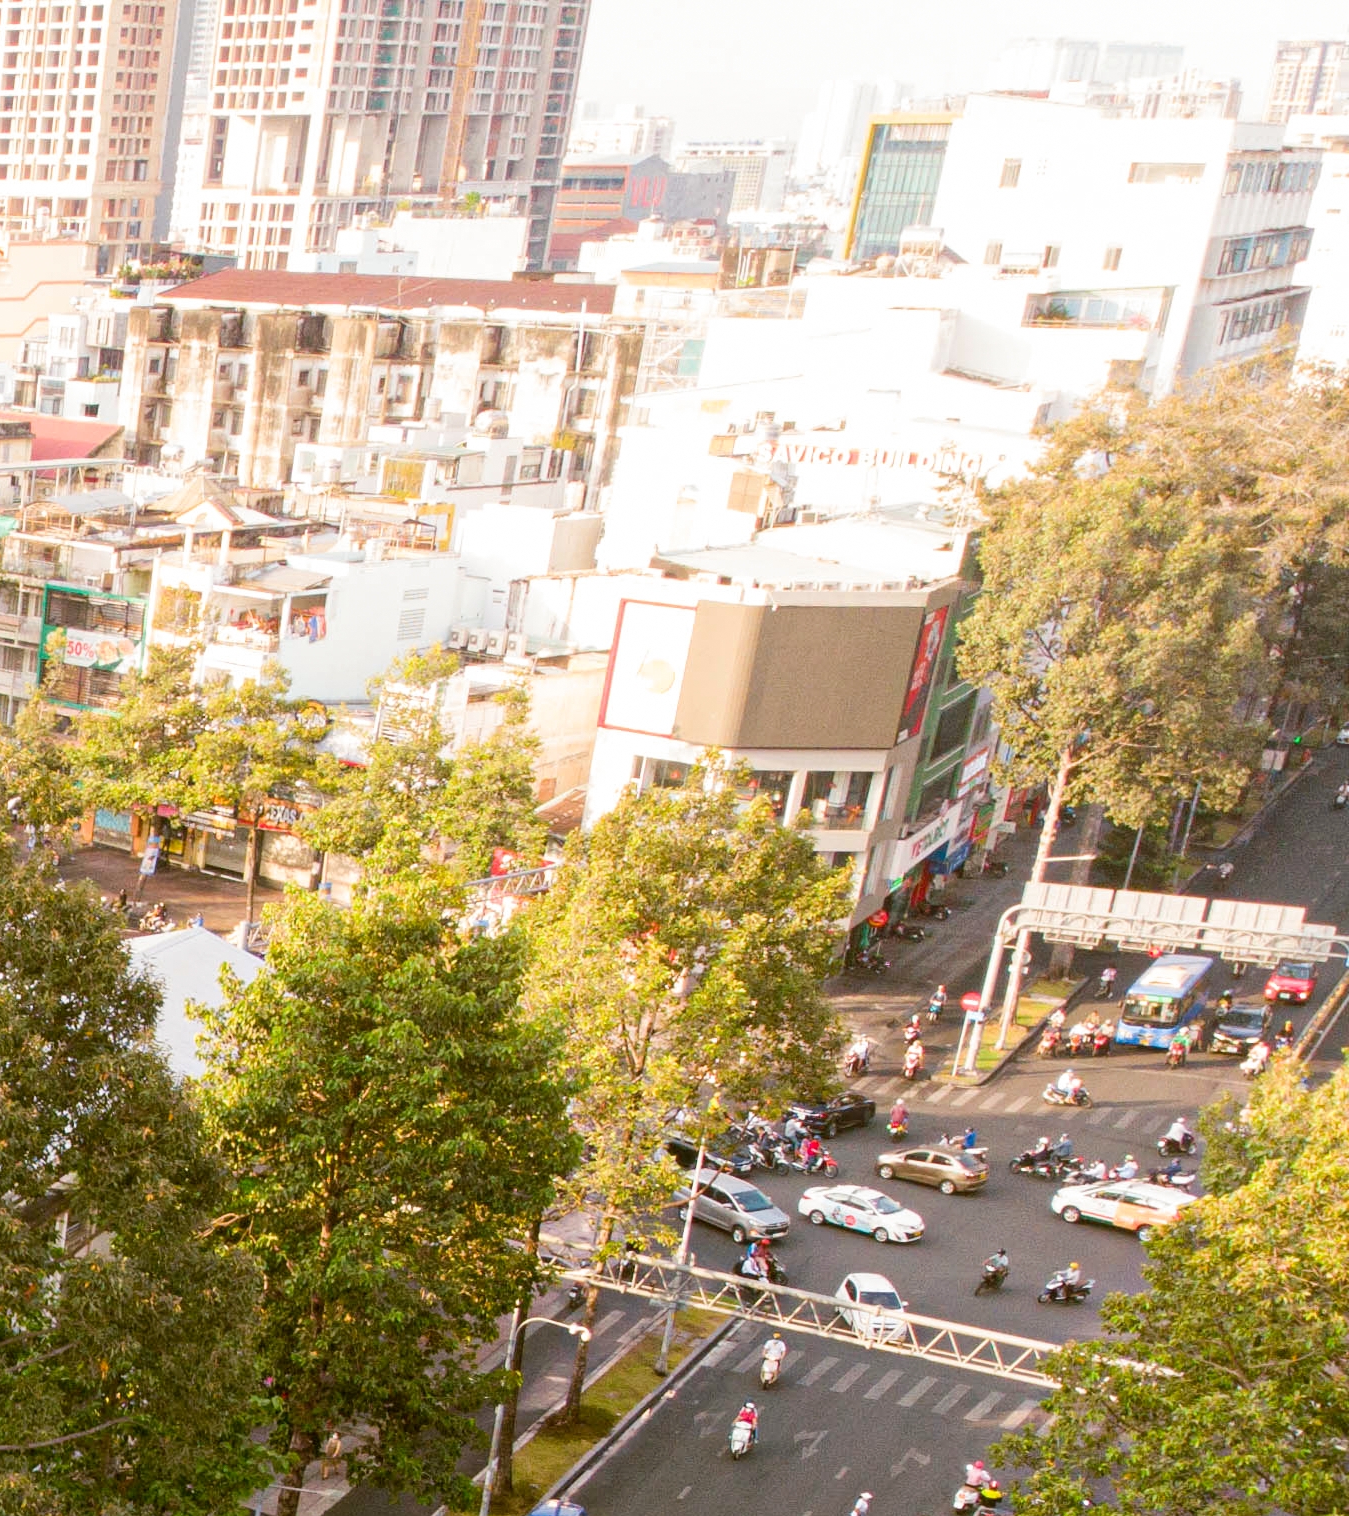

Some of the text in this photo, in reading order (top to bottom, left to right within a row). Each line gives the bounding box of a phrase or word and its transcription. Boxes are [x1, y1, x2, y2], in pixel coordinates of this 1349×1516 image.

[757, 442, 984, 473] SAVICO BUILDING
[67, 640, 95, 658] 50%
